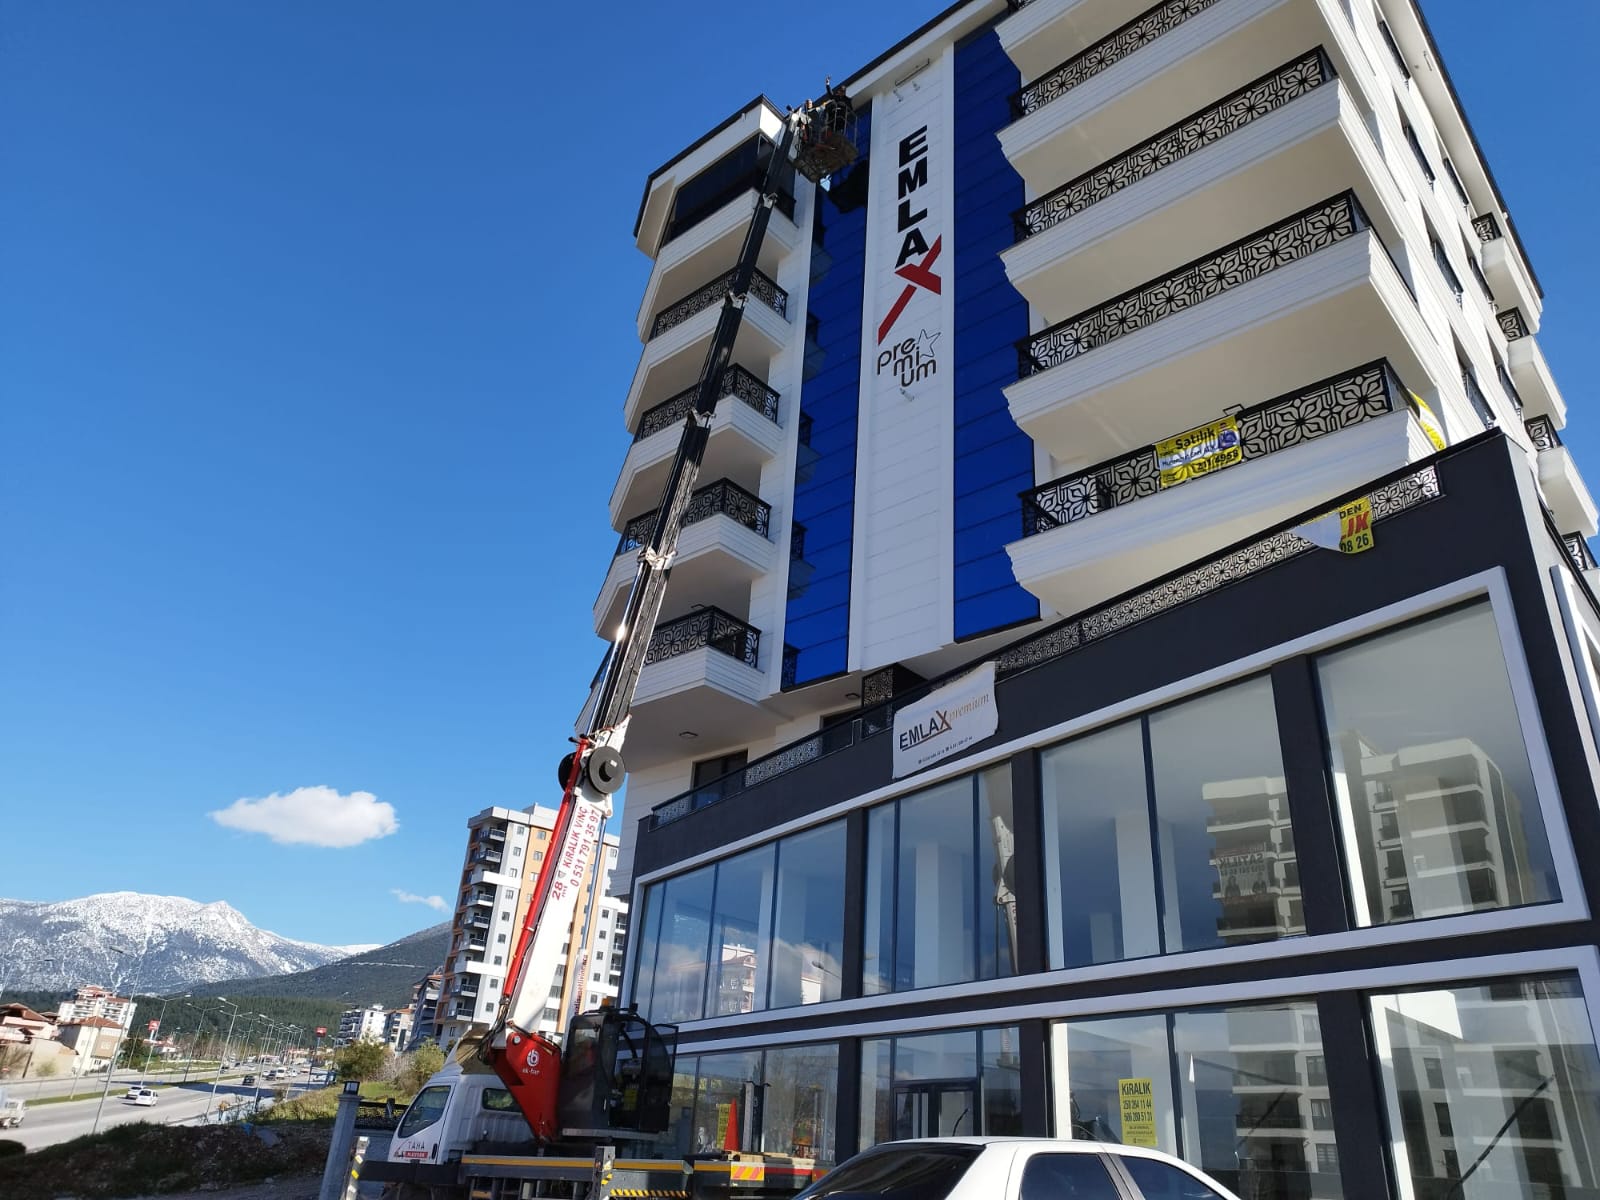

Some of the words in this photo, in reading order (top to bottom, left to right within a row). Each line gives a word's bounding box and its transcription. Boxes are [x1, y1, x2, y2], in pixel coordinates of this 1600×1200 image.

[877, 125, 942, 346] EMLAX
[1339, 504, 1362, 518] DEN
[1341, 511, 1369, 540] IK
[1356, 533, 1369, 549] 26
[899, 710, 952, 750] EMLAX
[949, 694, 989, 722] premium
[588, 809, 601, 824] 97
[585, 823, 596, 837] 35
[579, 839, 592, 857] 791
[572, 859, 586, 878] 531
[552, 881, 564, 900] 28
[570, 879, 580, 887] 0
